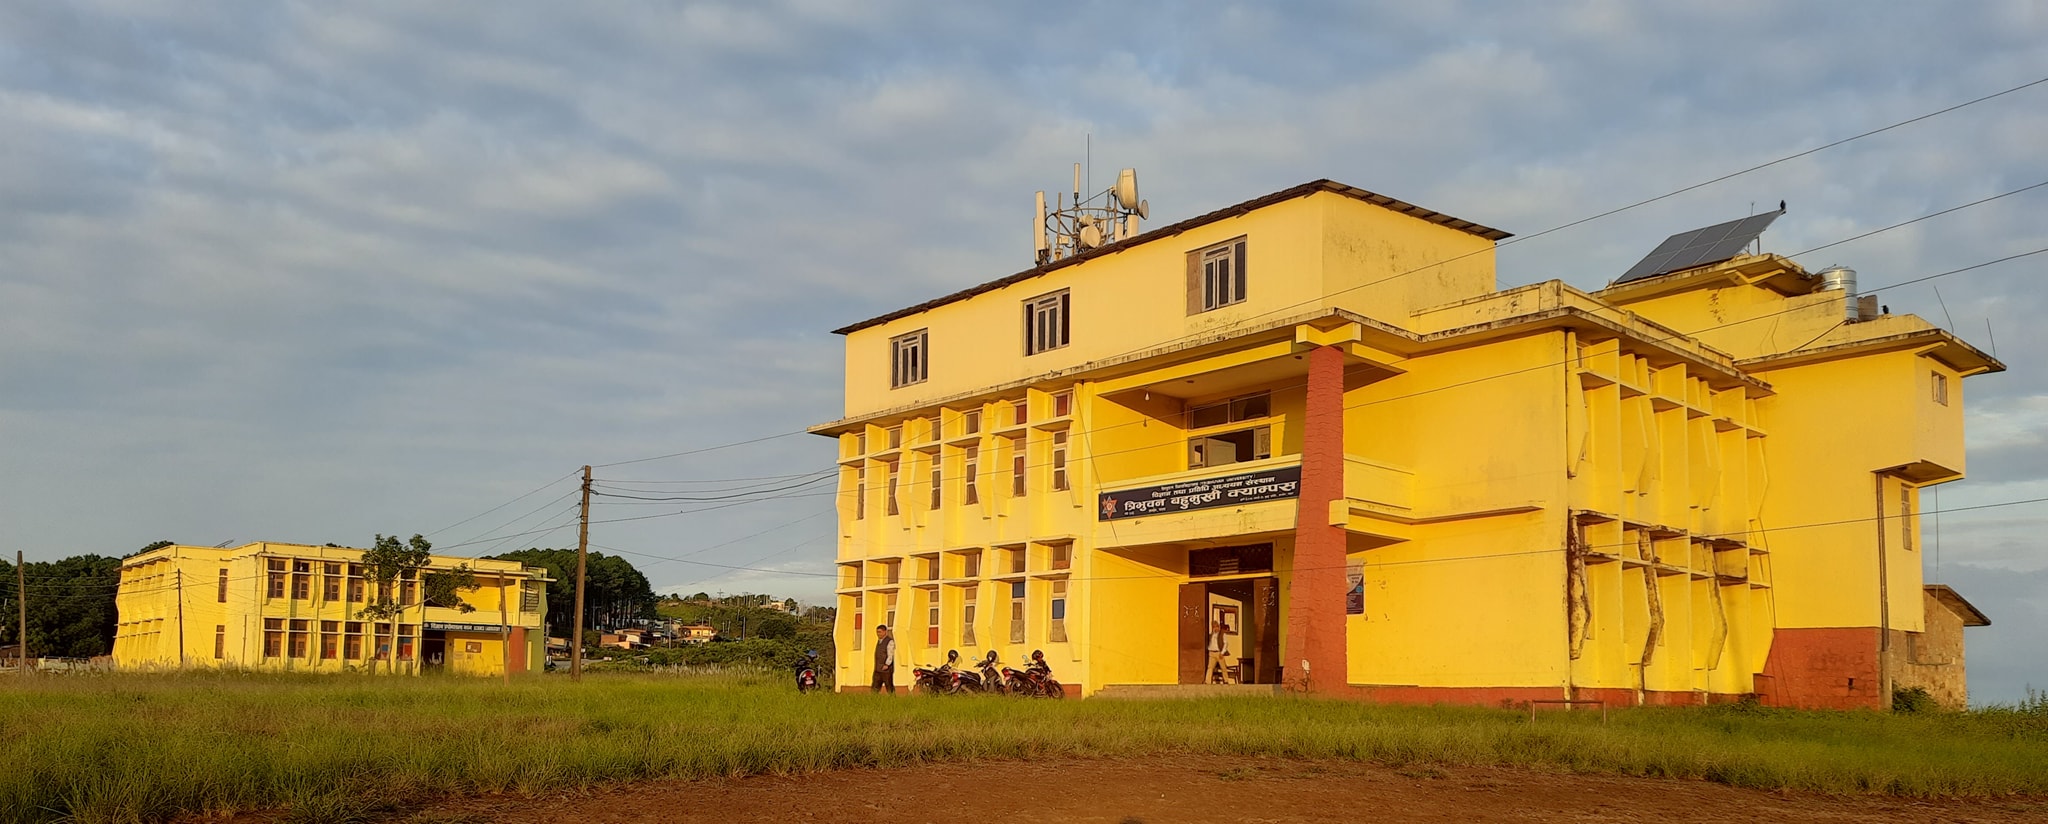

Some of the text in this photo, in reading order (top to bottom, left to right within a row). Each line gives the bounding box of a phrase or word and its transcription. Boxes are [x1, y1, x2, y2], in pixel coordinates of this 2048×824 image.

[1245, 476, 1275, 486] संस्थान
[1124, 498, 1166, 511] त्रिभुवन
[1170, 489, 1222, 510] बहुमुखी
[1227, 481, 1298, 498] क्याम्पस
